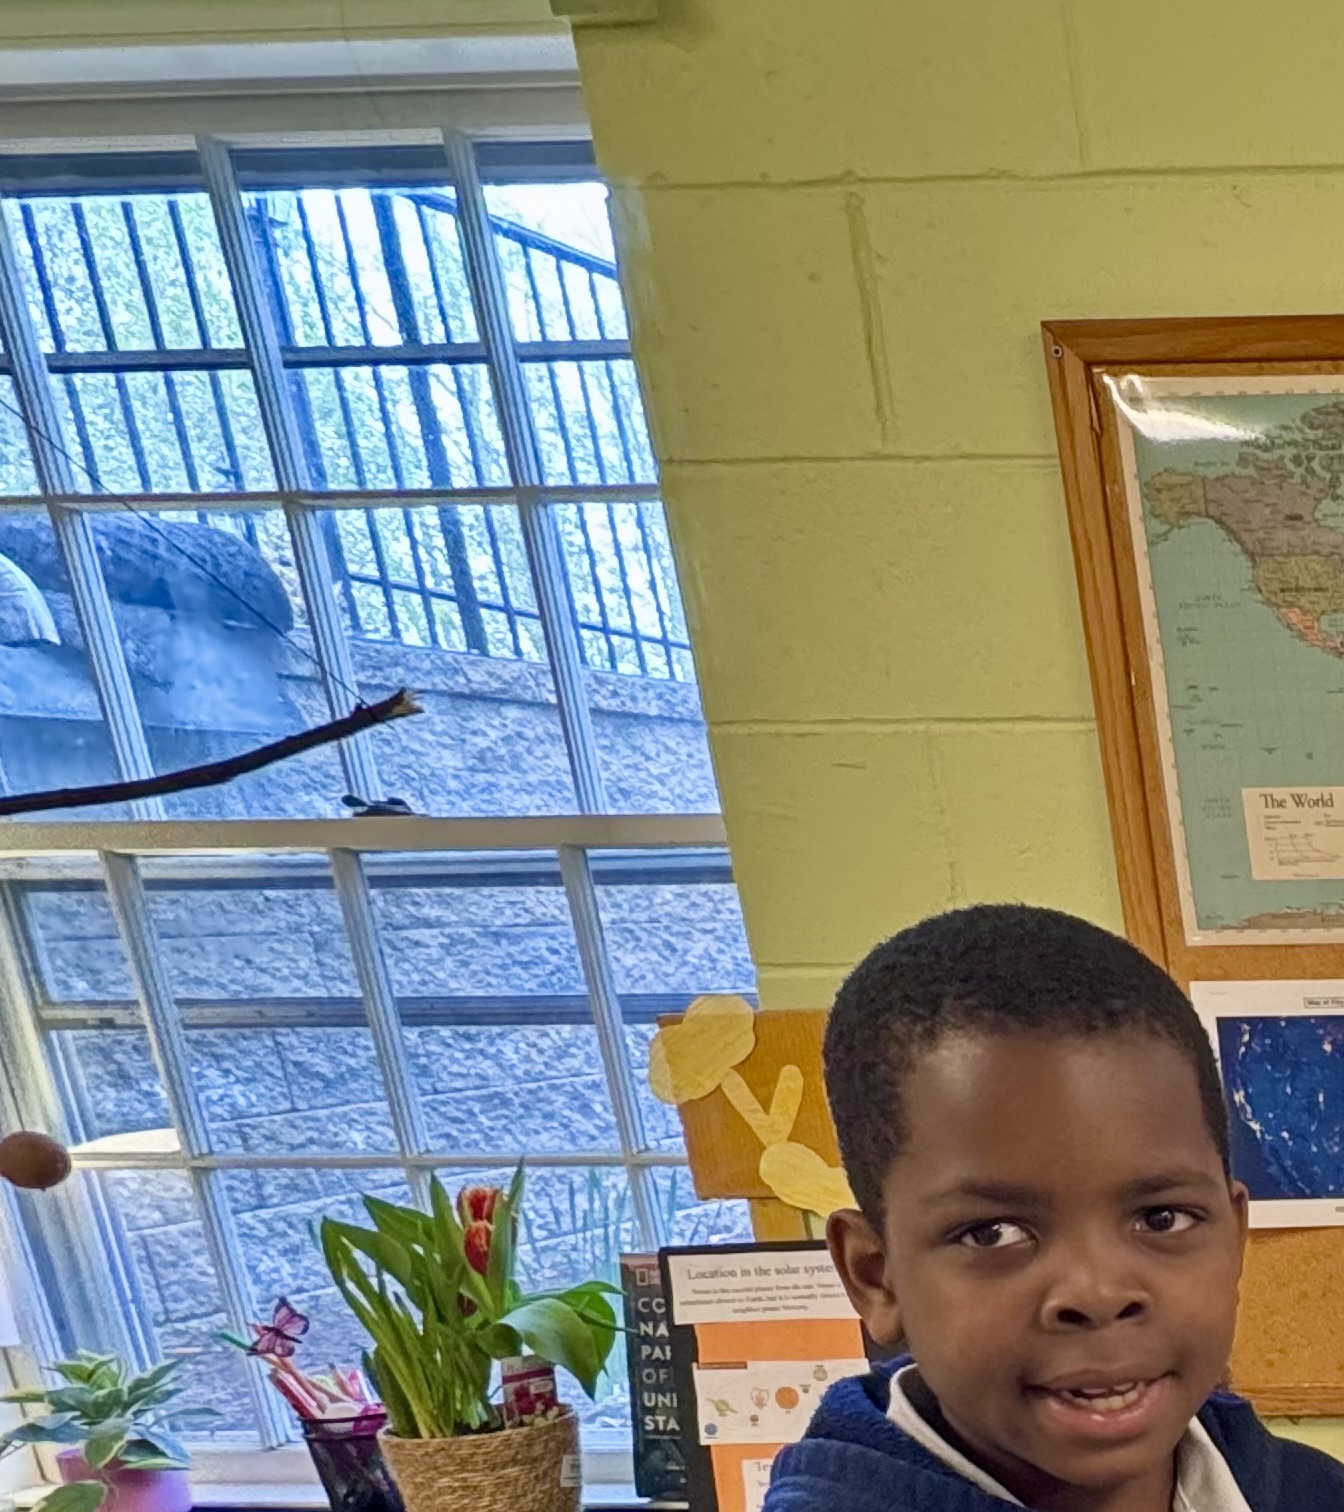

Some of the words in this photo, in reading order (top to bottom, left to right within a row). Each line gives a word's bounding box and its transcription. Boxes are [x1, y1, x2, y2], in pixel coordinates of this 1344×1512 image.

[1259, 792, 1288, 809] The
[1289, 791, 1335, 809] World
[687, 1267, 738, 1281] Location
[741, 1265, 752, 1277] in
[754, 1265, 772, 1277] the
[775, 1264, 800, 1276] solar
[803, 1264, 836, 1278] syste
[642, 1368, 668, 1384] OF
